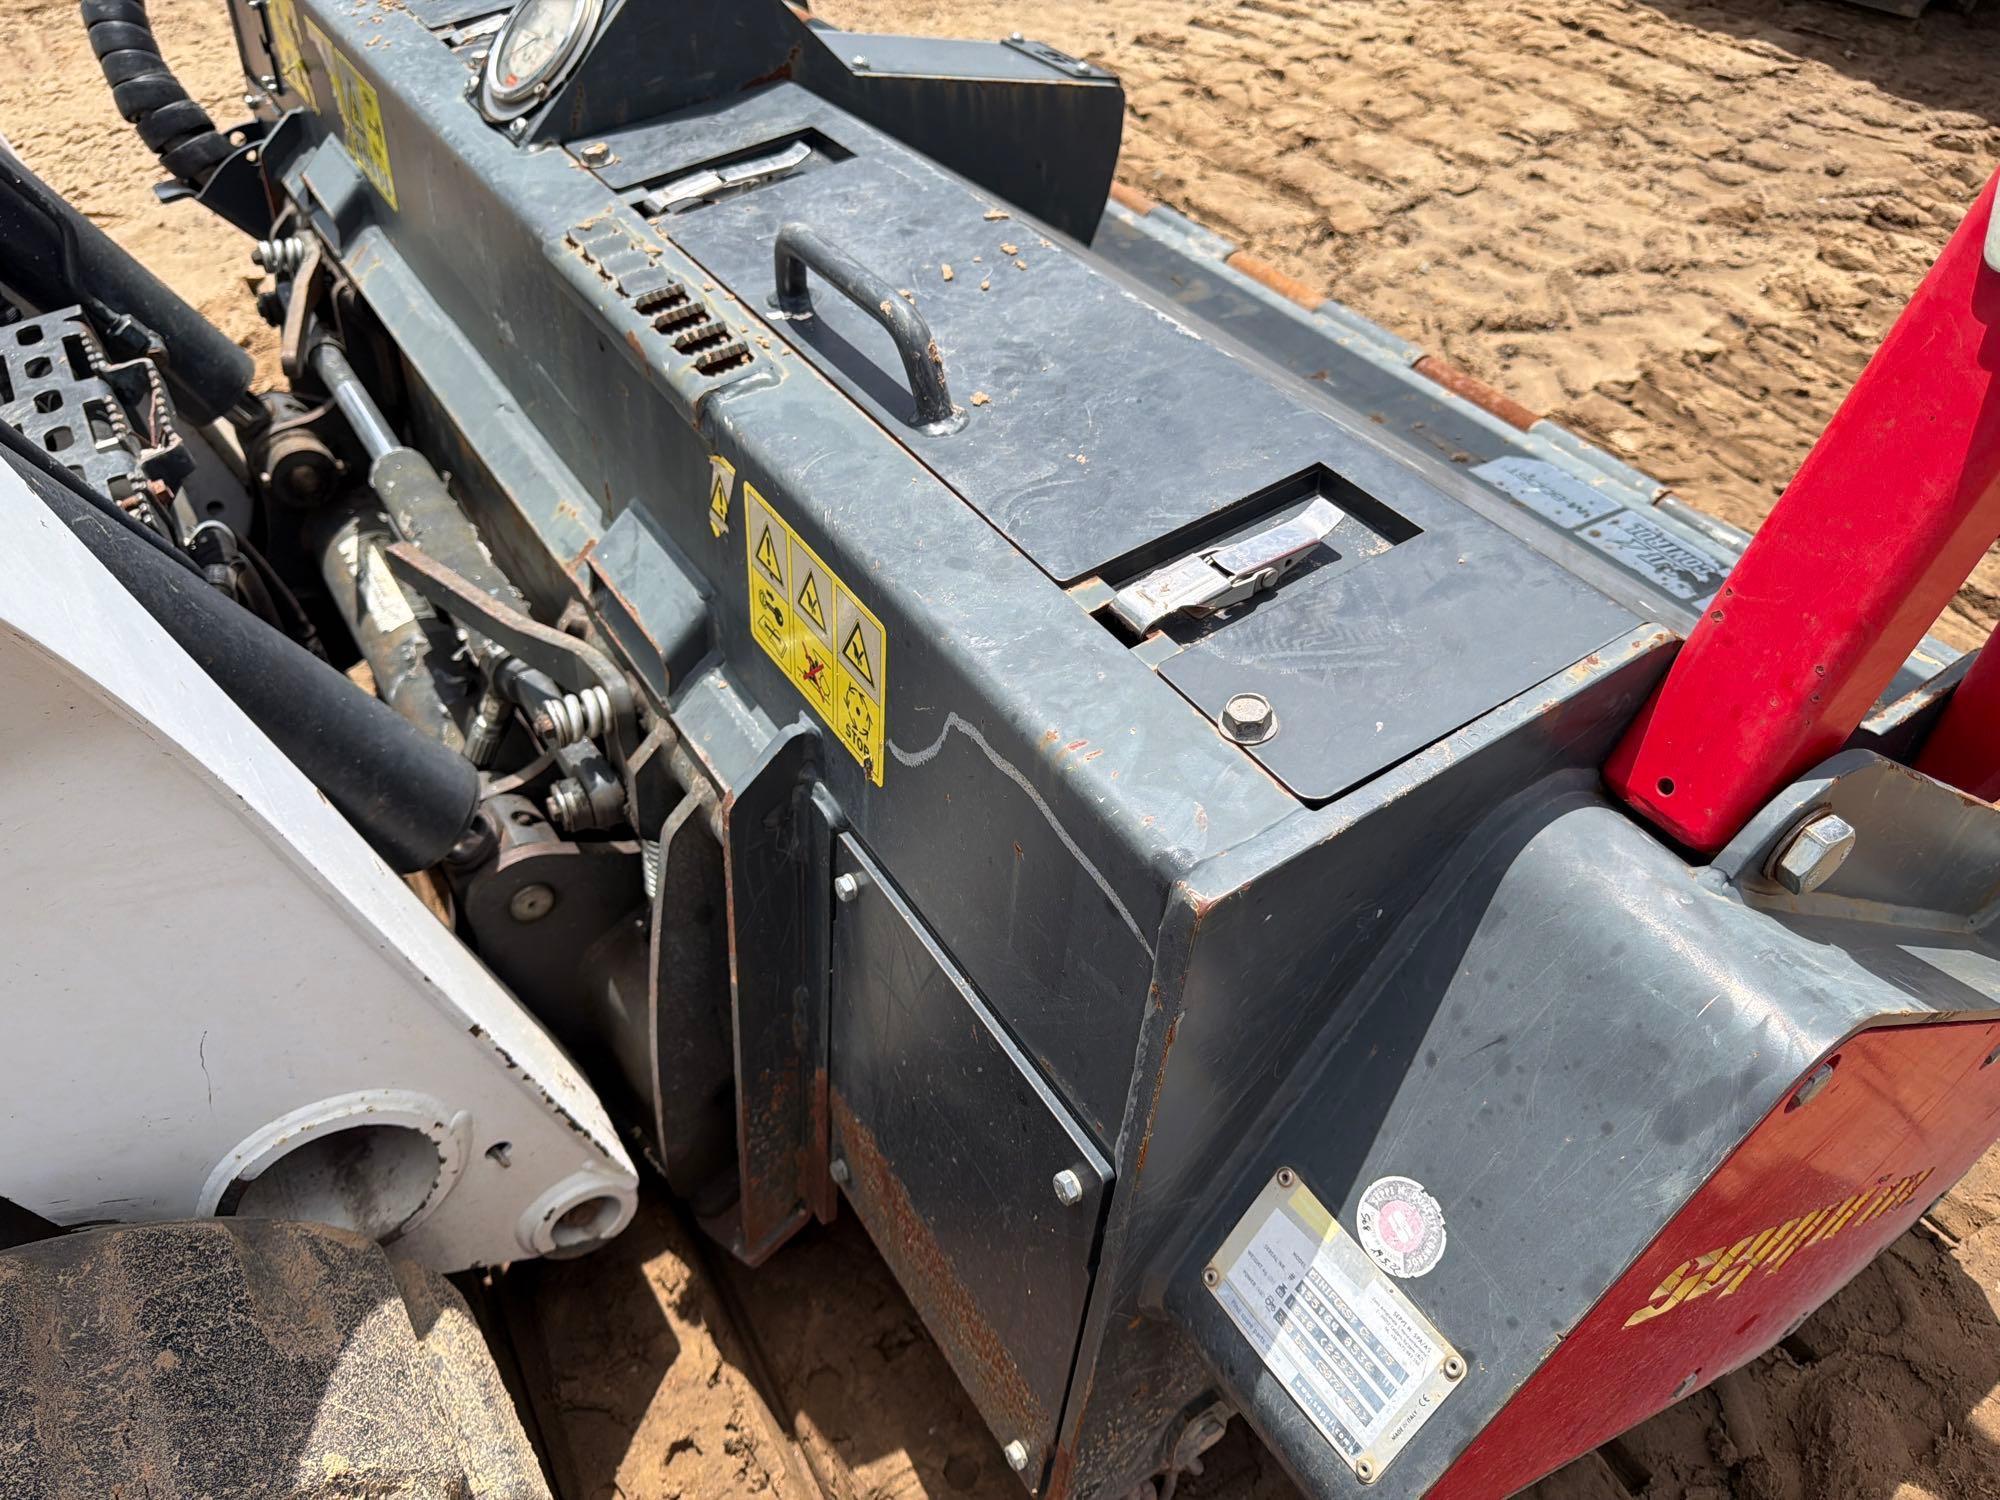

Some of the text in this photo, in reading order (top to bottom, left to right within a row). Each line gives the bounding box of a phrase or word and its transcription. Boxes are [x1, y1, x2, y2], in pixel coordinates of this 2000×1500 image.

[1627, 522, 1714, 578] CONTROL
[844, 722, 871, 758] STOP
[1291, 1250, 1307, 1270] MODEL
[1392, 1310, 1407, 1327] SEPPI
[1415, 1392, 1431, 1409] CE
